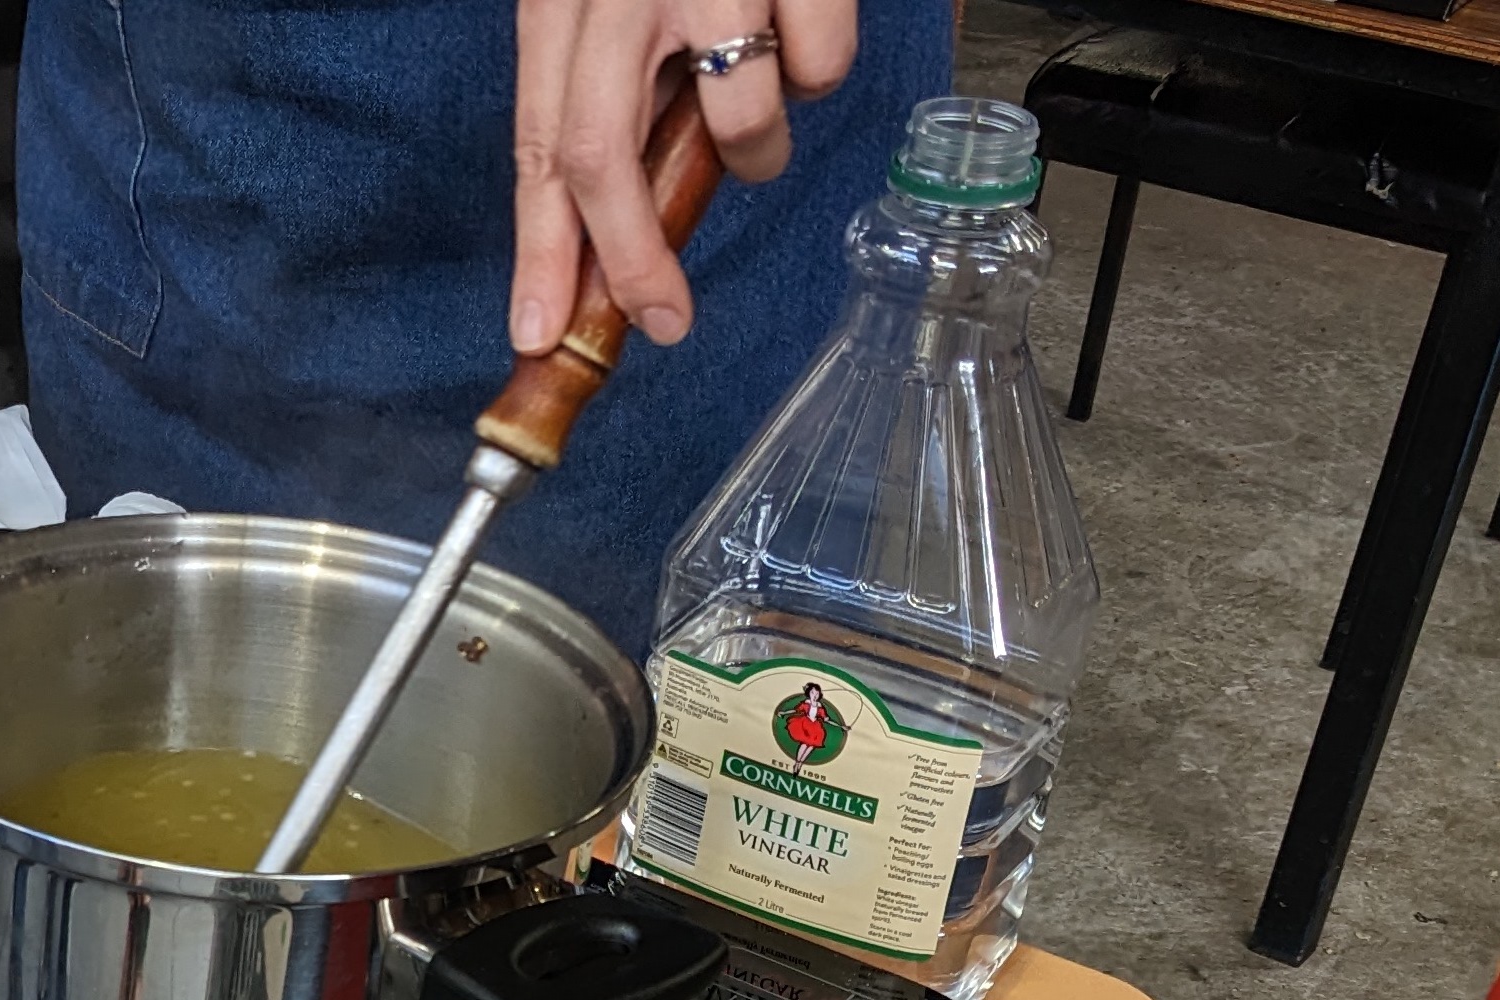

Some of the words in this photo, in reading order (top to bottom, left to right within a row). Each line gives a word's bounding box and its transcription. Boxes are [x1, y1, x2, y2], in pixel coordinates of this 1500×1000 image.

[771, 758, 791, 771] EST
[725, 755, 874, 819] CORNWELL'S
[732, 794, 850, 858] WHITE
[738, 828, 831, 876] VINEGAR
[888, 836, 917, 849] Perfect
[916, 861, 934, 870] eggs
[728, 863, 773, 888] Naturally
[773, 879, 825, 904] Fermented
[757, 897, 765, 907] 2
[765, 899, 785, 915] Litre
